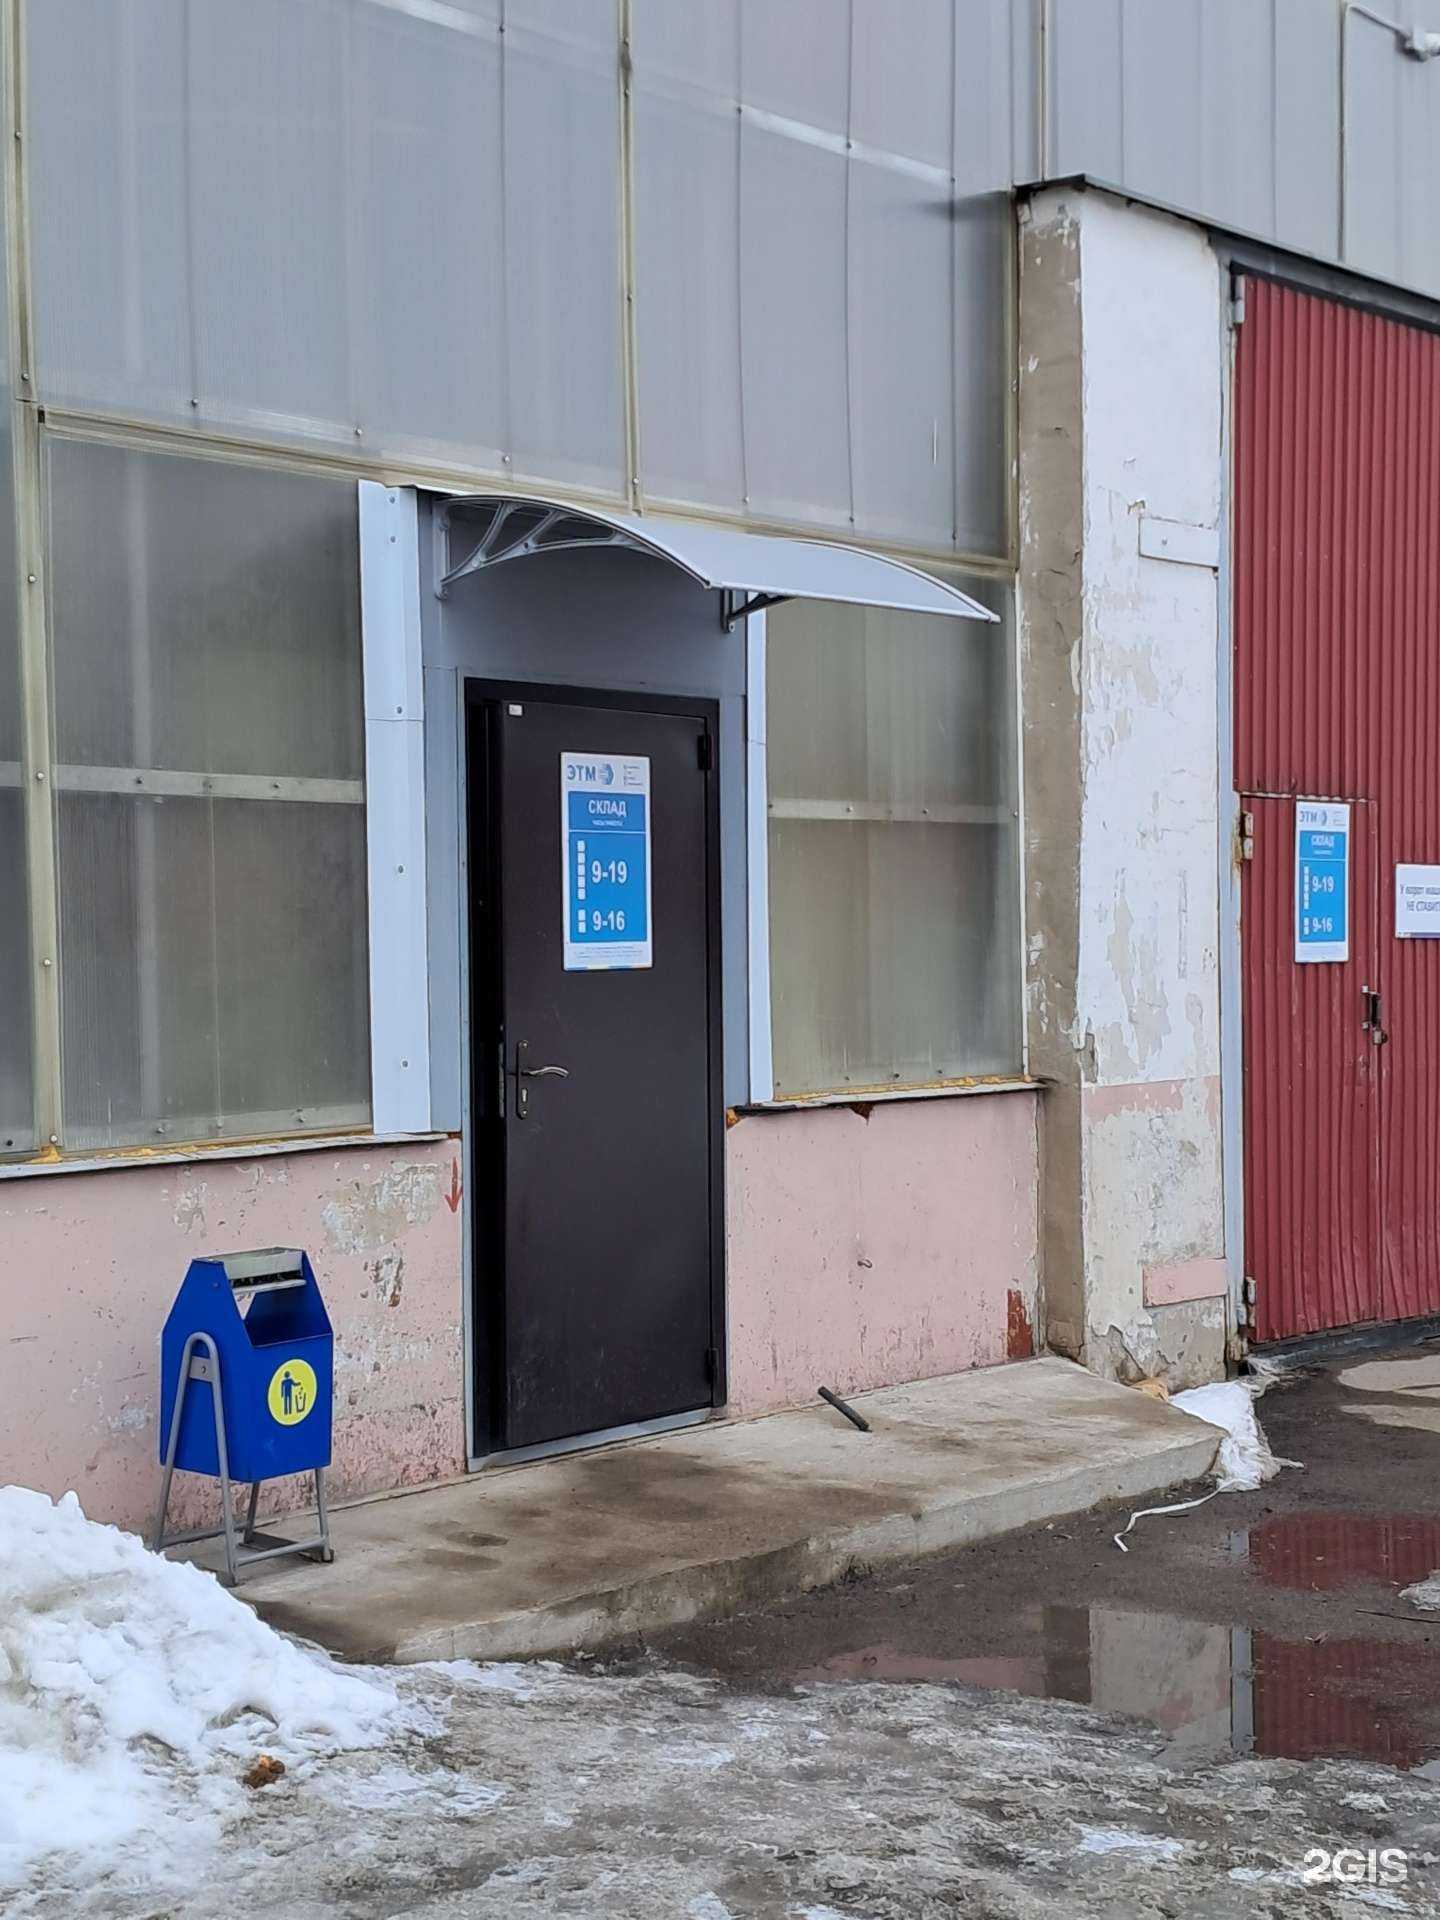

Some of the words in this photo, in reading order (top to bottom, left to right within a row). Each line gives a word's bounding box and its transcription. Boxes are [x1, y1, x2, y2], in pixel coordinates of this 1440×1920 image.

[567, 764, 597, 782] ЭТМ
[588, 799, 627, 818] СКЛАД
[591, 860, 628, 884] 9-19
[1312, 876, 1335, 894] 9-19
[592, 909, 626, 932] 9-16
[1312, 917, 1334, 933] 9-16
